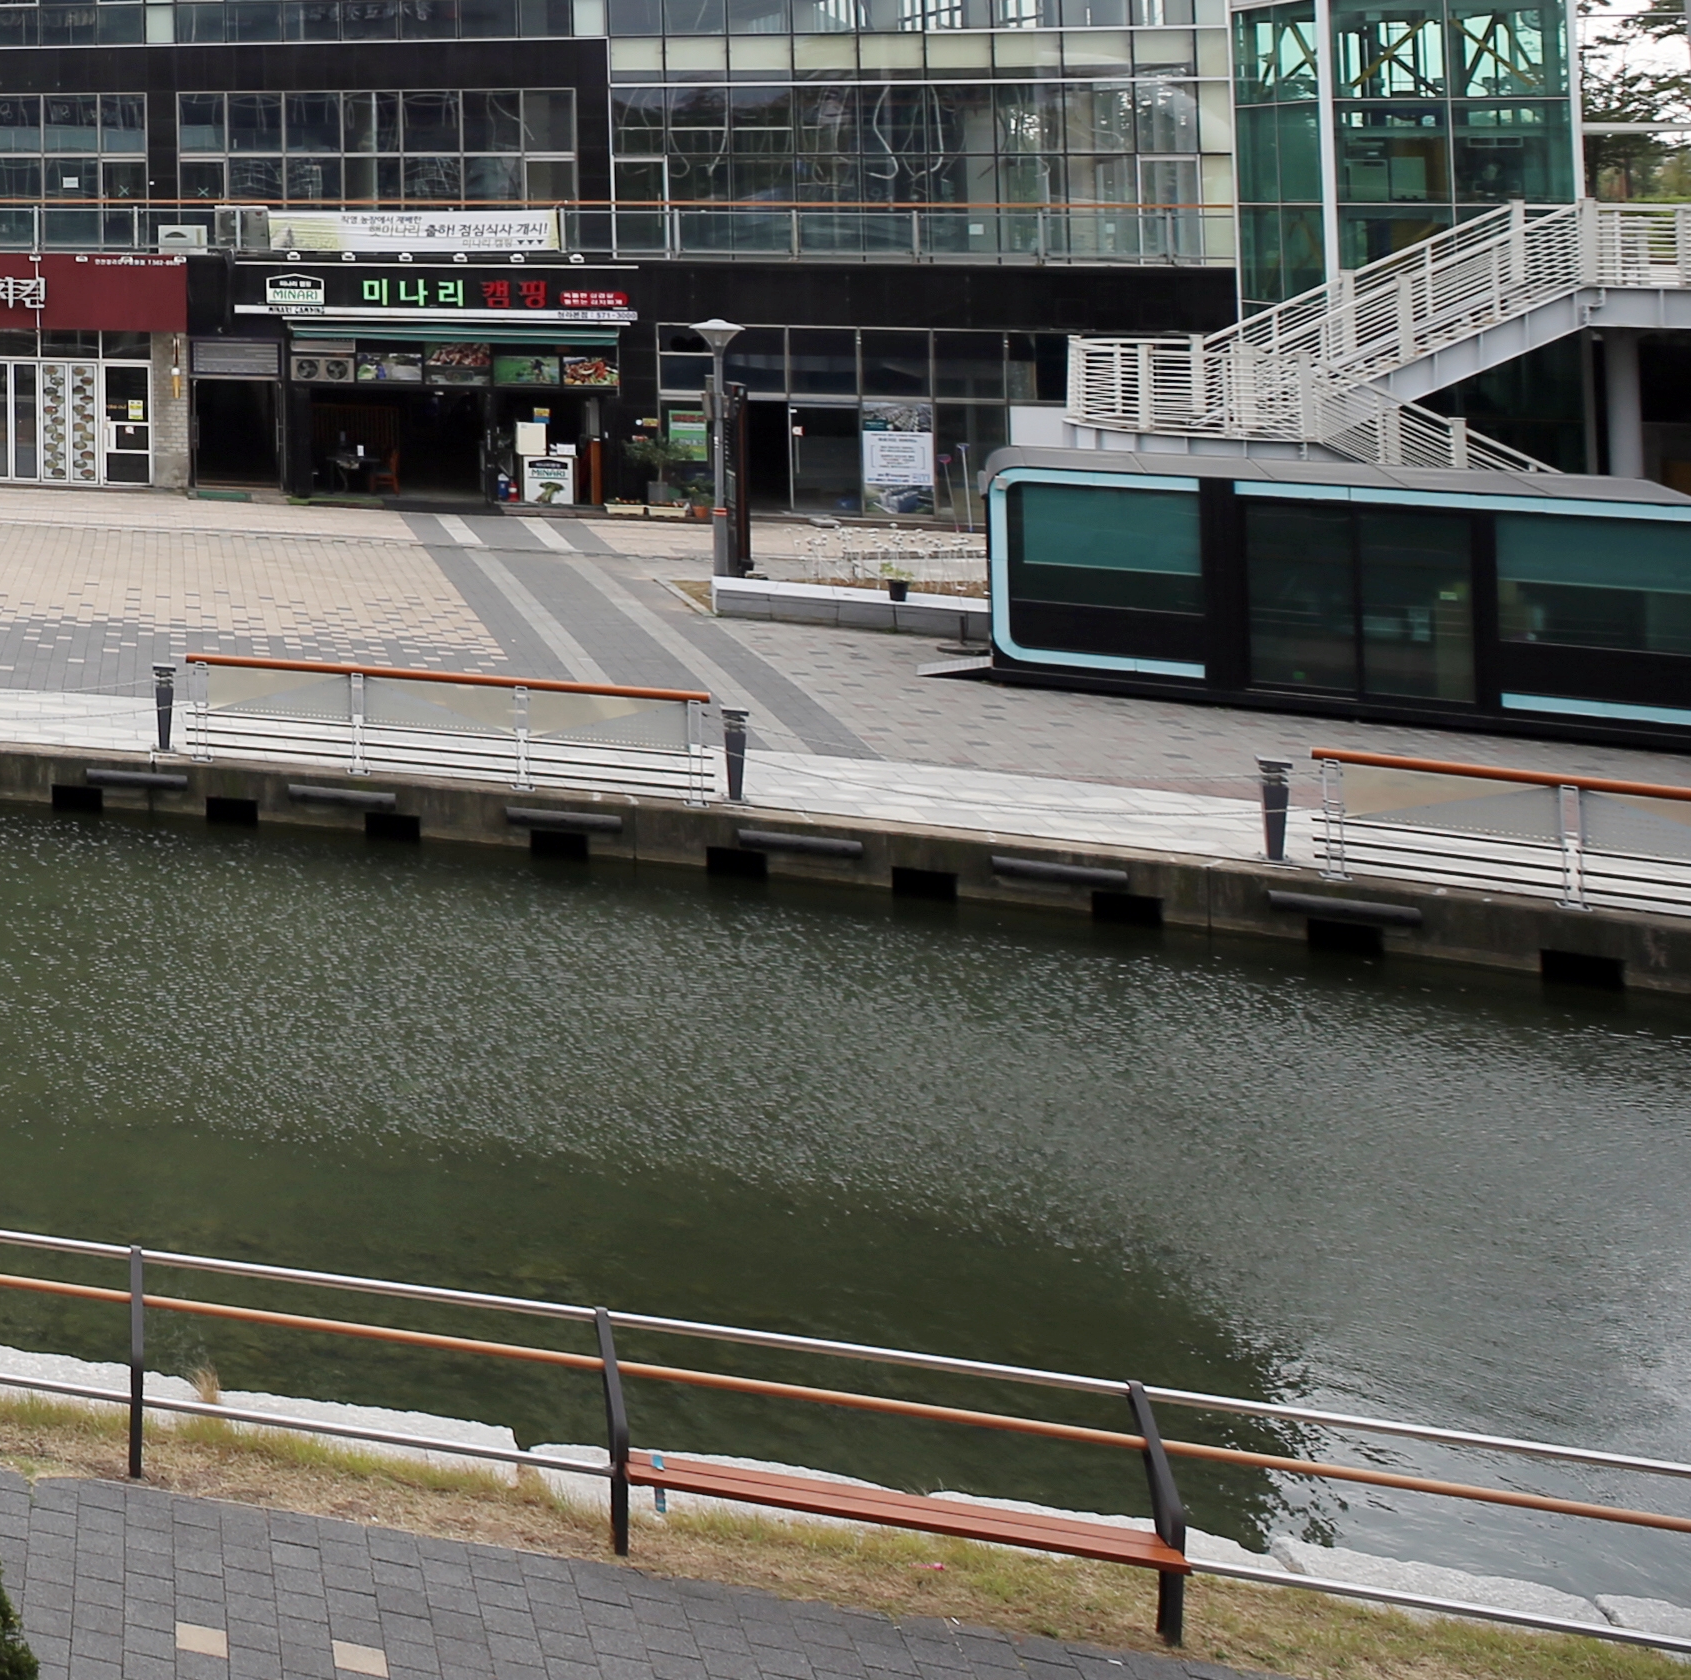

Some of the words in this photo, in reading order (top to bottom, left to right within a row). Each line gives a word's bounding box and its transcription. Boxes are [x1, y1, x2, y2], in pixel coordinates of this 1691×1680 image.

[425, 223, 456, 238] 출하!
[459, 223, 512, 236] 점심식사
[516, 222, 549, 235] 개시!
[273, 289, 318, 300] MINARI
[362, 278, 464, 307] 미나리
[481, 280, 547, 309] 캠핑
